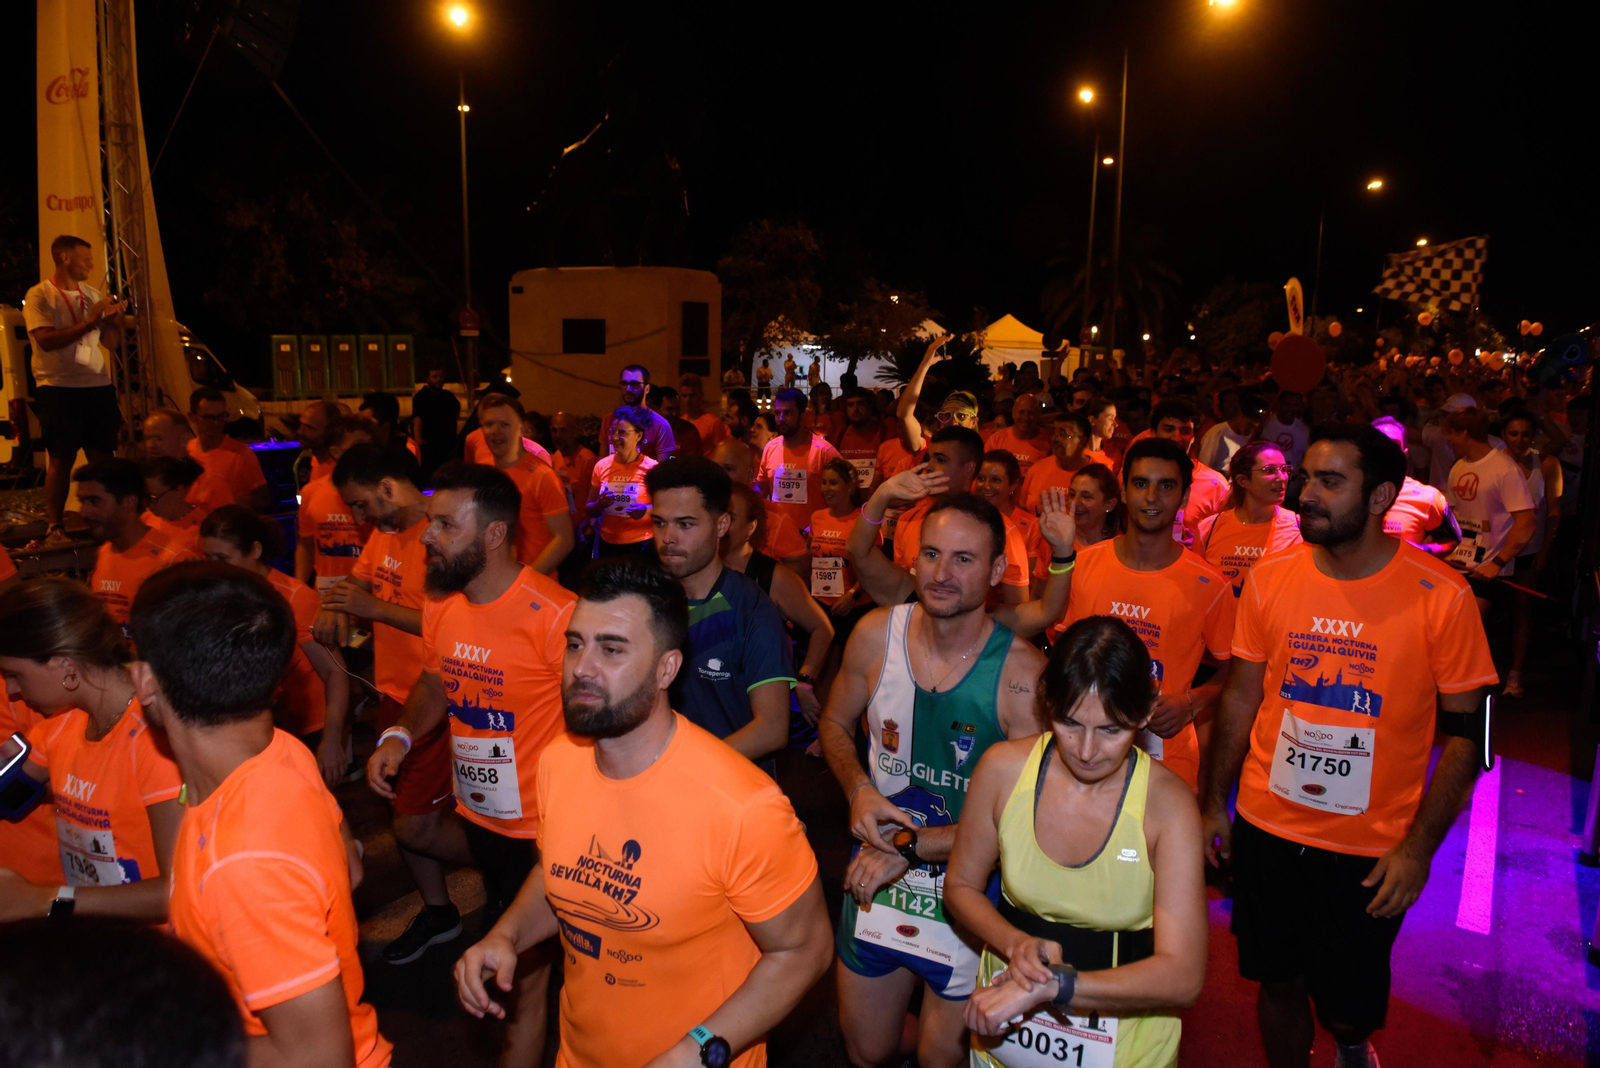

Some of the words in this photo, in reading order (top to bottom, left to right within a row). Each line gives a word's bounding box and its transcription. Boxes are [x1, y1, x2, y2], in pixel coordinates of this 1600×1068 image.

[778, 481, 800, 489] 15979
[822, 530, 841, 538] XXXV
[1234, 546, 1267, 557] XXXV
[815, 572, 837, 580] 15987
[1109, 601, 1151, 620] XXXV
[1126, 618, 1161, 631] NOCTURNA
[1131, 626, 1161, 639] QUIVIR
[1310, 616, 1364, 639] XXXV
[1288, 631, 1329, 644] CARRERA
[1332, 637, 1378, 652] NOCTURNA
[1293, 641, 1377, 662] GUADALQUIVIR
[453, 642, 491, 664] XXXV
[442, 656, 465, 668] CARRERA
[467, 662, 504, 676] NOCTURNA
[444, 665, 504, 686] GUADALQUIVIR
[1285, 746, 1351, 777] 21750
[63, 773, 97, 802] XXXV
[550, 863, 602, 890] SEVILLA
[577, 855, 642, 890] NOCTURNA
[889, 887, 937, 918] 1142
[926, 947, 951, 960] Cruzcampo
[1003, 1021, 1085, 1068] 20031
